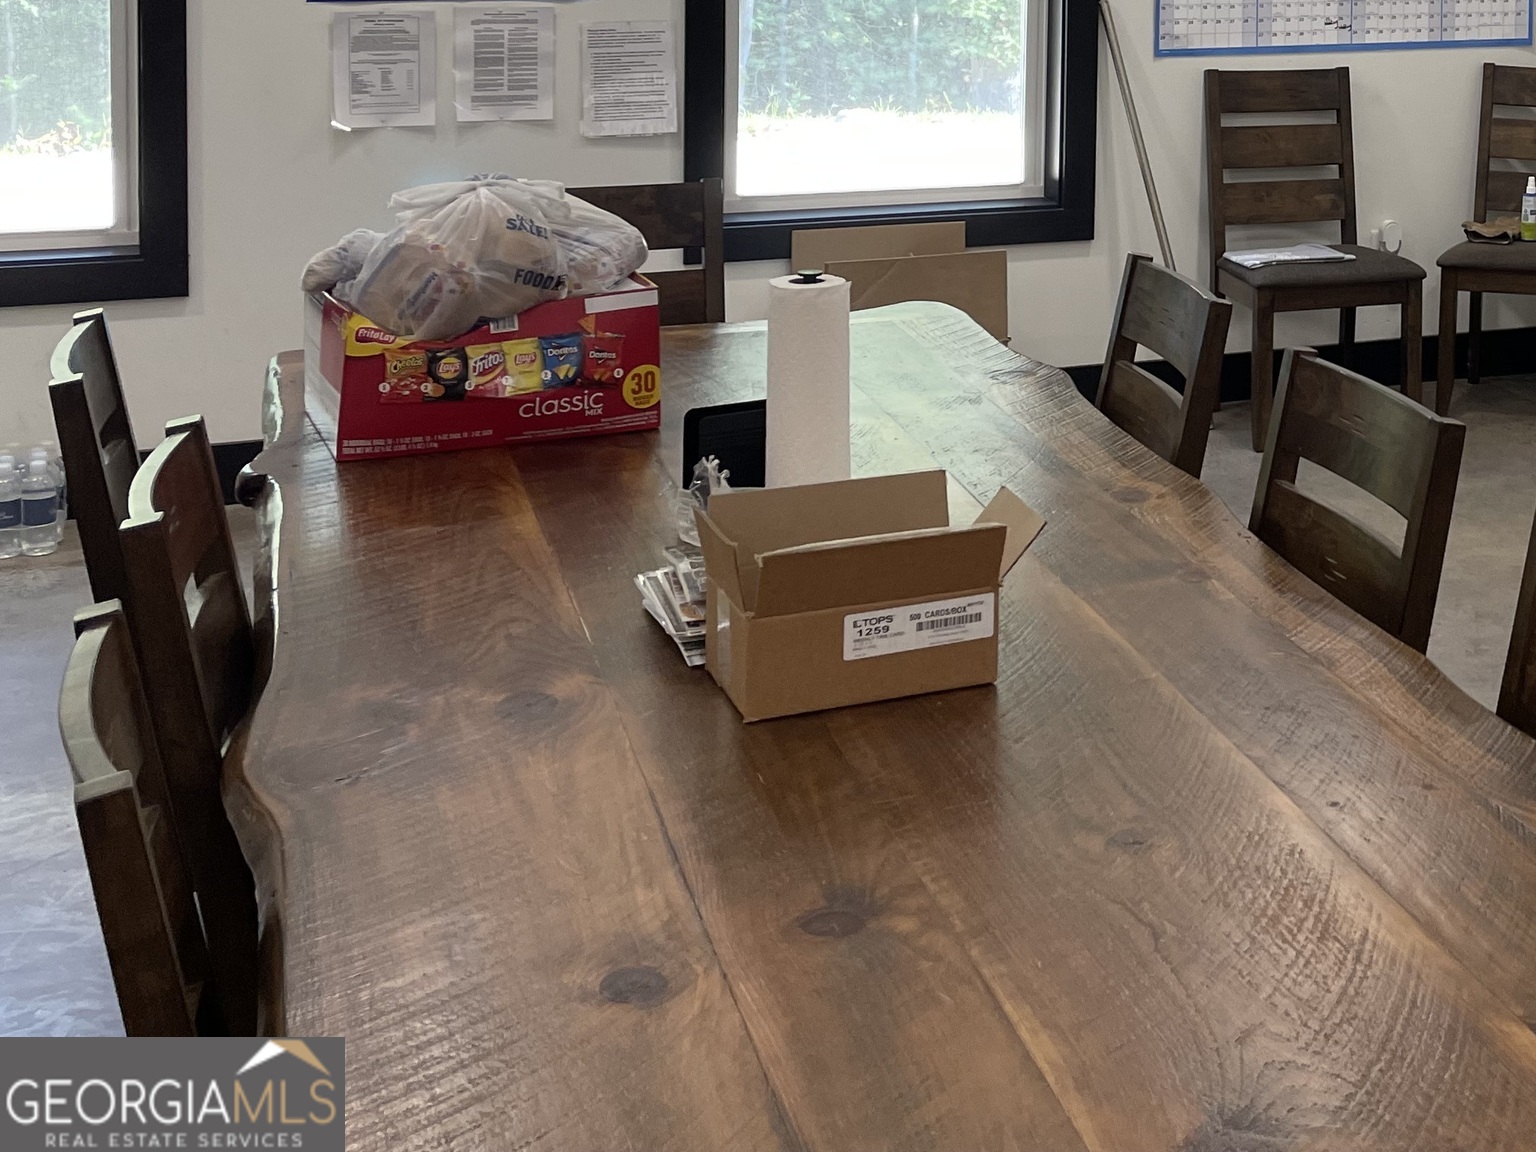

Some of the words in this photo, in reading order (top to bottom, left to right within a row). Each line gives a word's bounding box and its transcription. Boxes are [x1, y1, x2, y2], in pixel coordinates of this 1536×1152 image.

[506, 218, 548, 240] SALE!
[548, 346, 578, 356] Doritos
[589, 351, 616, 359] Doritos
[473, 351, 504, 375] Fritos
[631, 371, 656, 395] 30
[519, 390, 603, 418] classic
[585, 408, 603, 416] MIX
[857, 626, 890, 637] 1259
